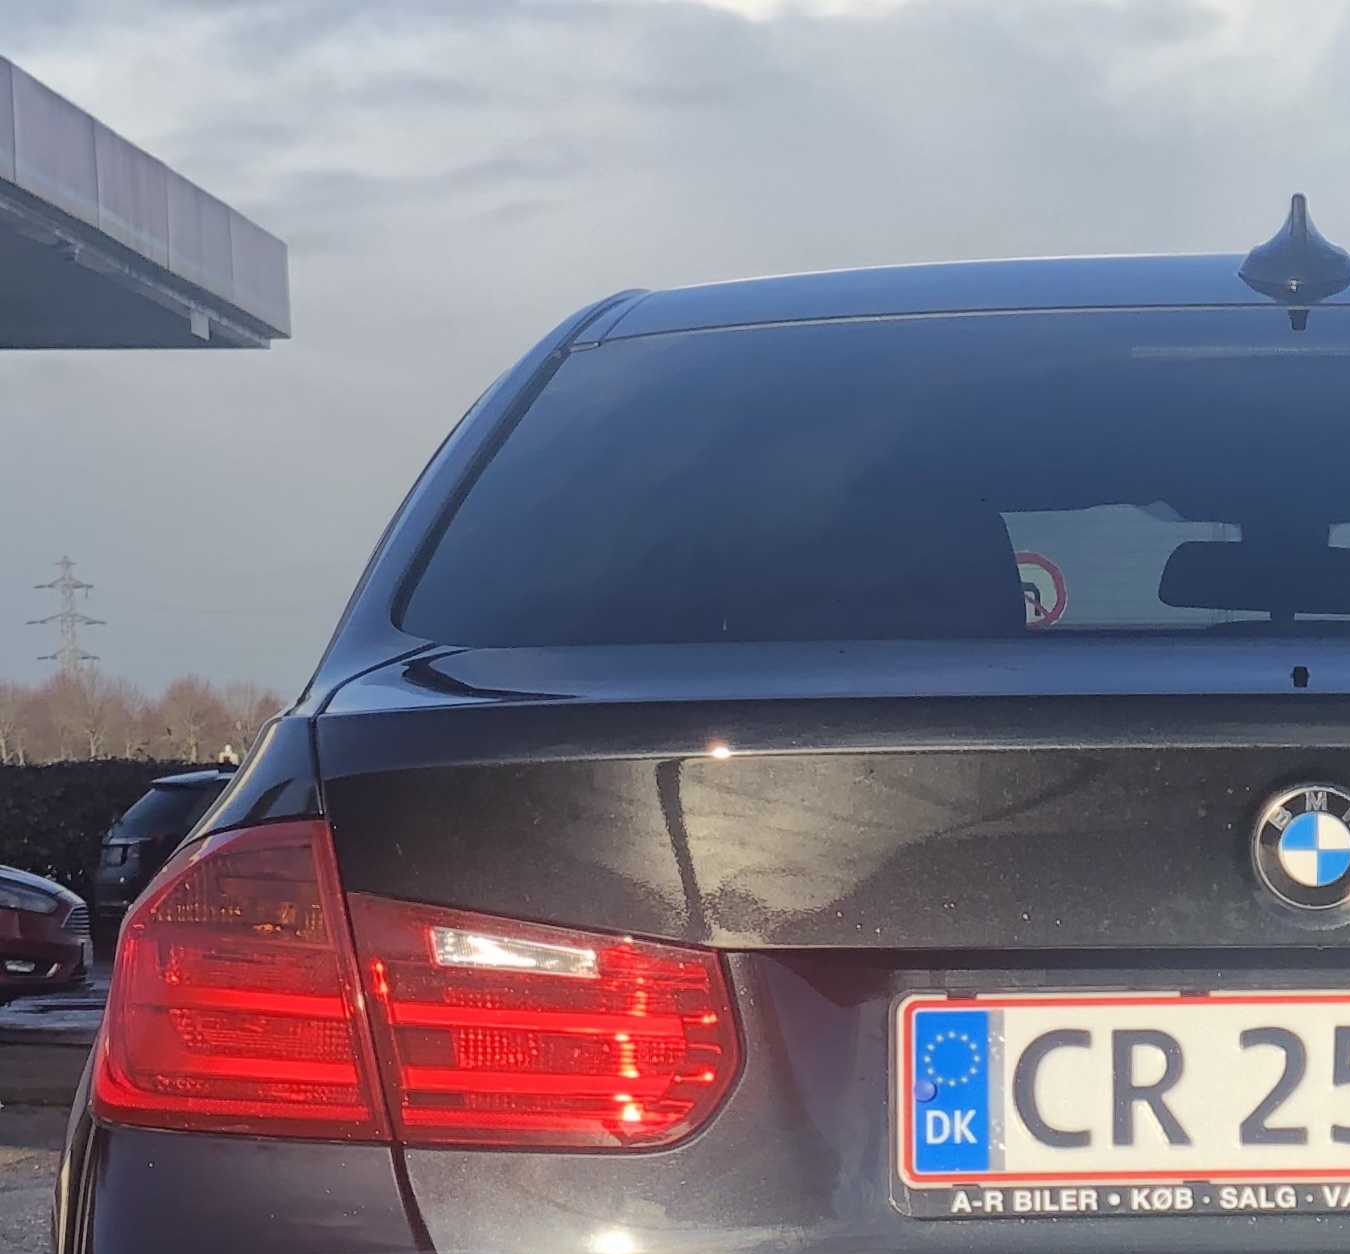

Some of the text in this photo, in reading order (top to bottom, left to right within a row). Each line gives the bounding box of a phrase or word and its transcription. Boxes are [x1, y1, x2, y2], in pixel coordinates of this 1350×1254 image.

[1012, 1028, 1193, 1149] CR
[925, 1108, 978, 1145] DK
[951, 1189, 1004, 1213] A-R
[1013, 1188, 1099, 1212] BILER
[1130, 1187, 1194, 1211] KØB
[1219, 1186, 1297, 1210] SALG
